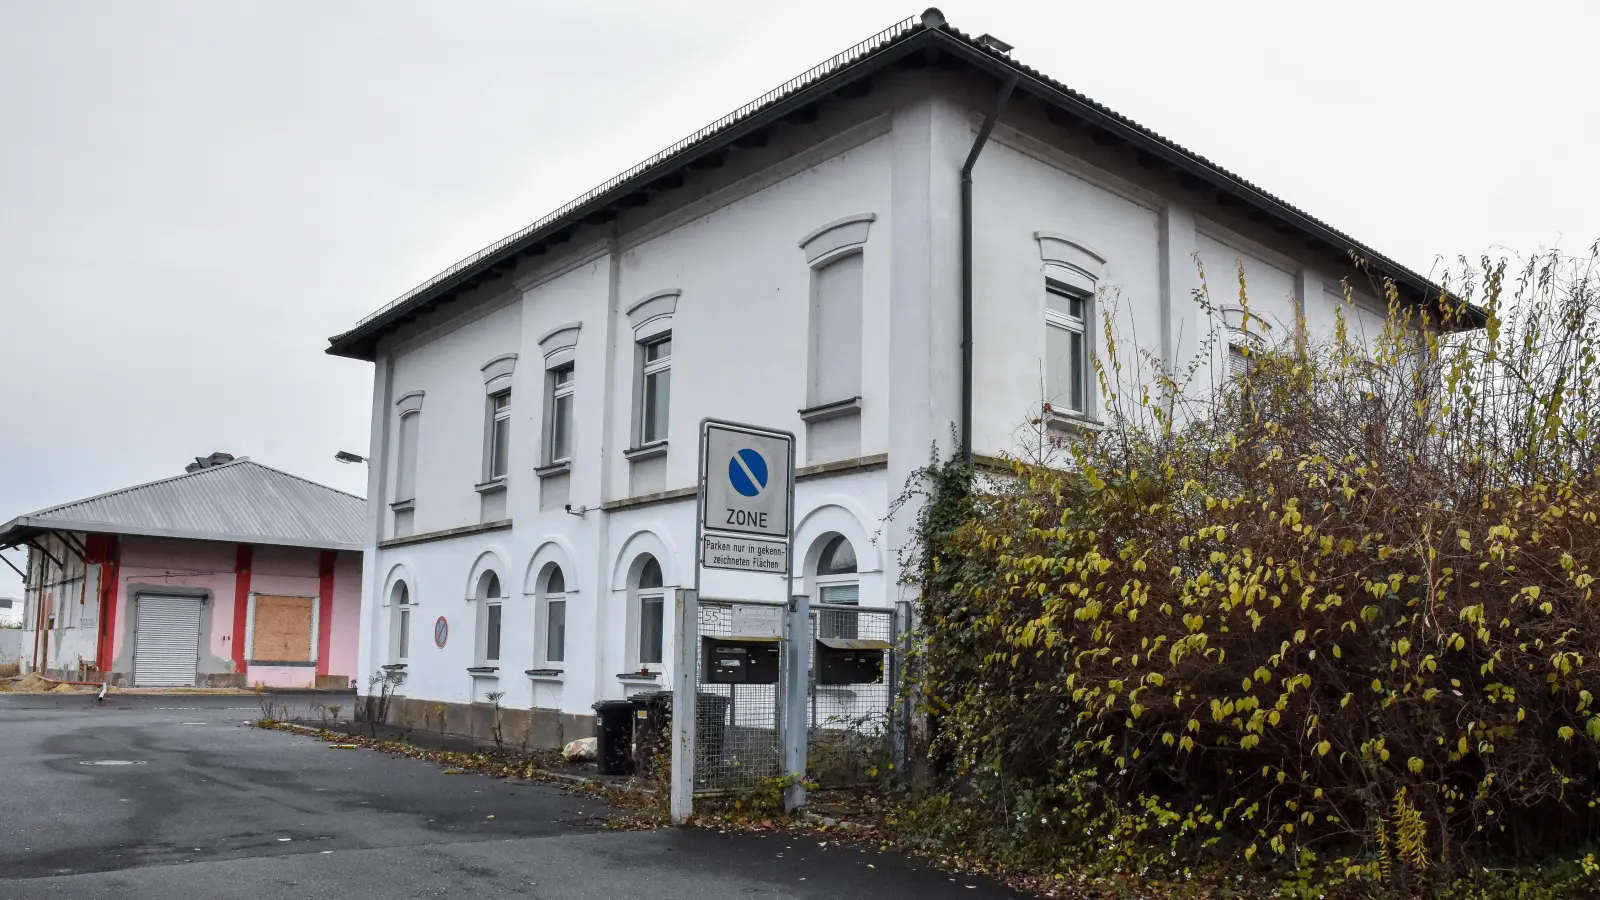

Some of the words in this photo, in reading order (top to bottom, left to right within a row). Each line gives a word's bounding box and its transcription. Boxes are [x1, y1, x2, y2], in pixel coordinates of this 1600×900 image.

[726, 508, 768, 528] ZONE
[706, 539, 731, 552] Parken
[733, 544, 745, 553] nur
[748, 543, 755, 554] in
[757, 546, 785, 556] gekenn-
[713, 555, 750, 567] zeichneten
[753, 557, 779, 569] Flächen
[704, 610, 719, 622] 55
